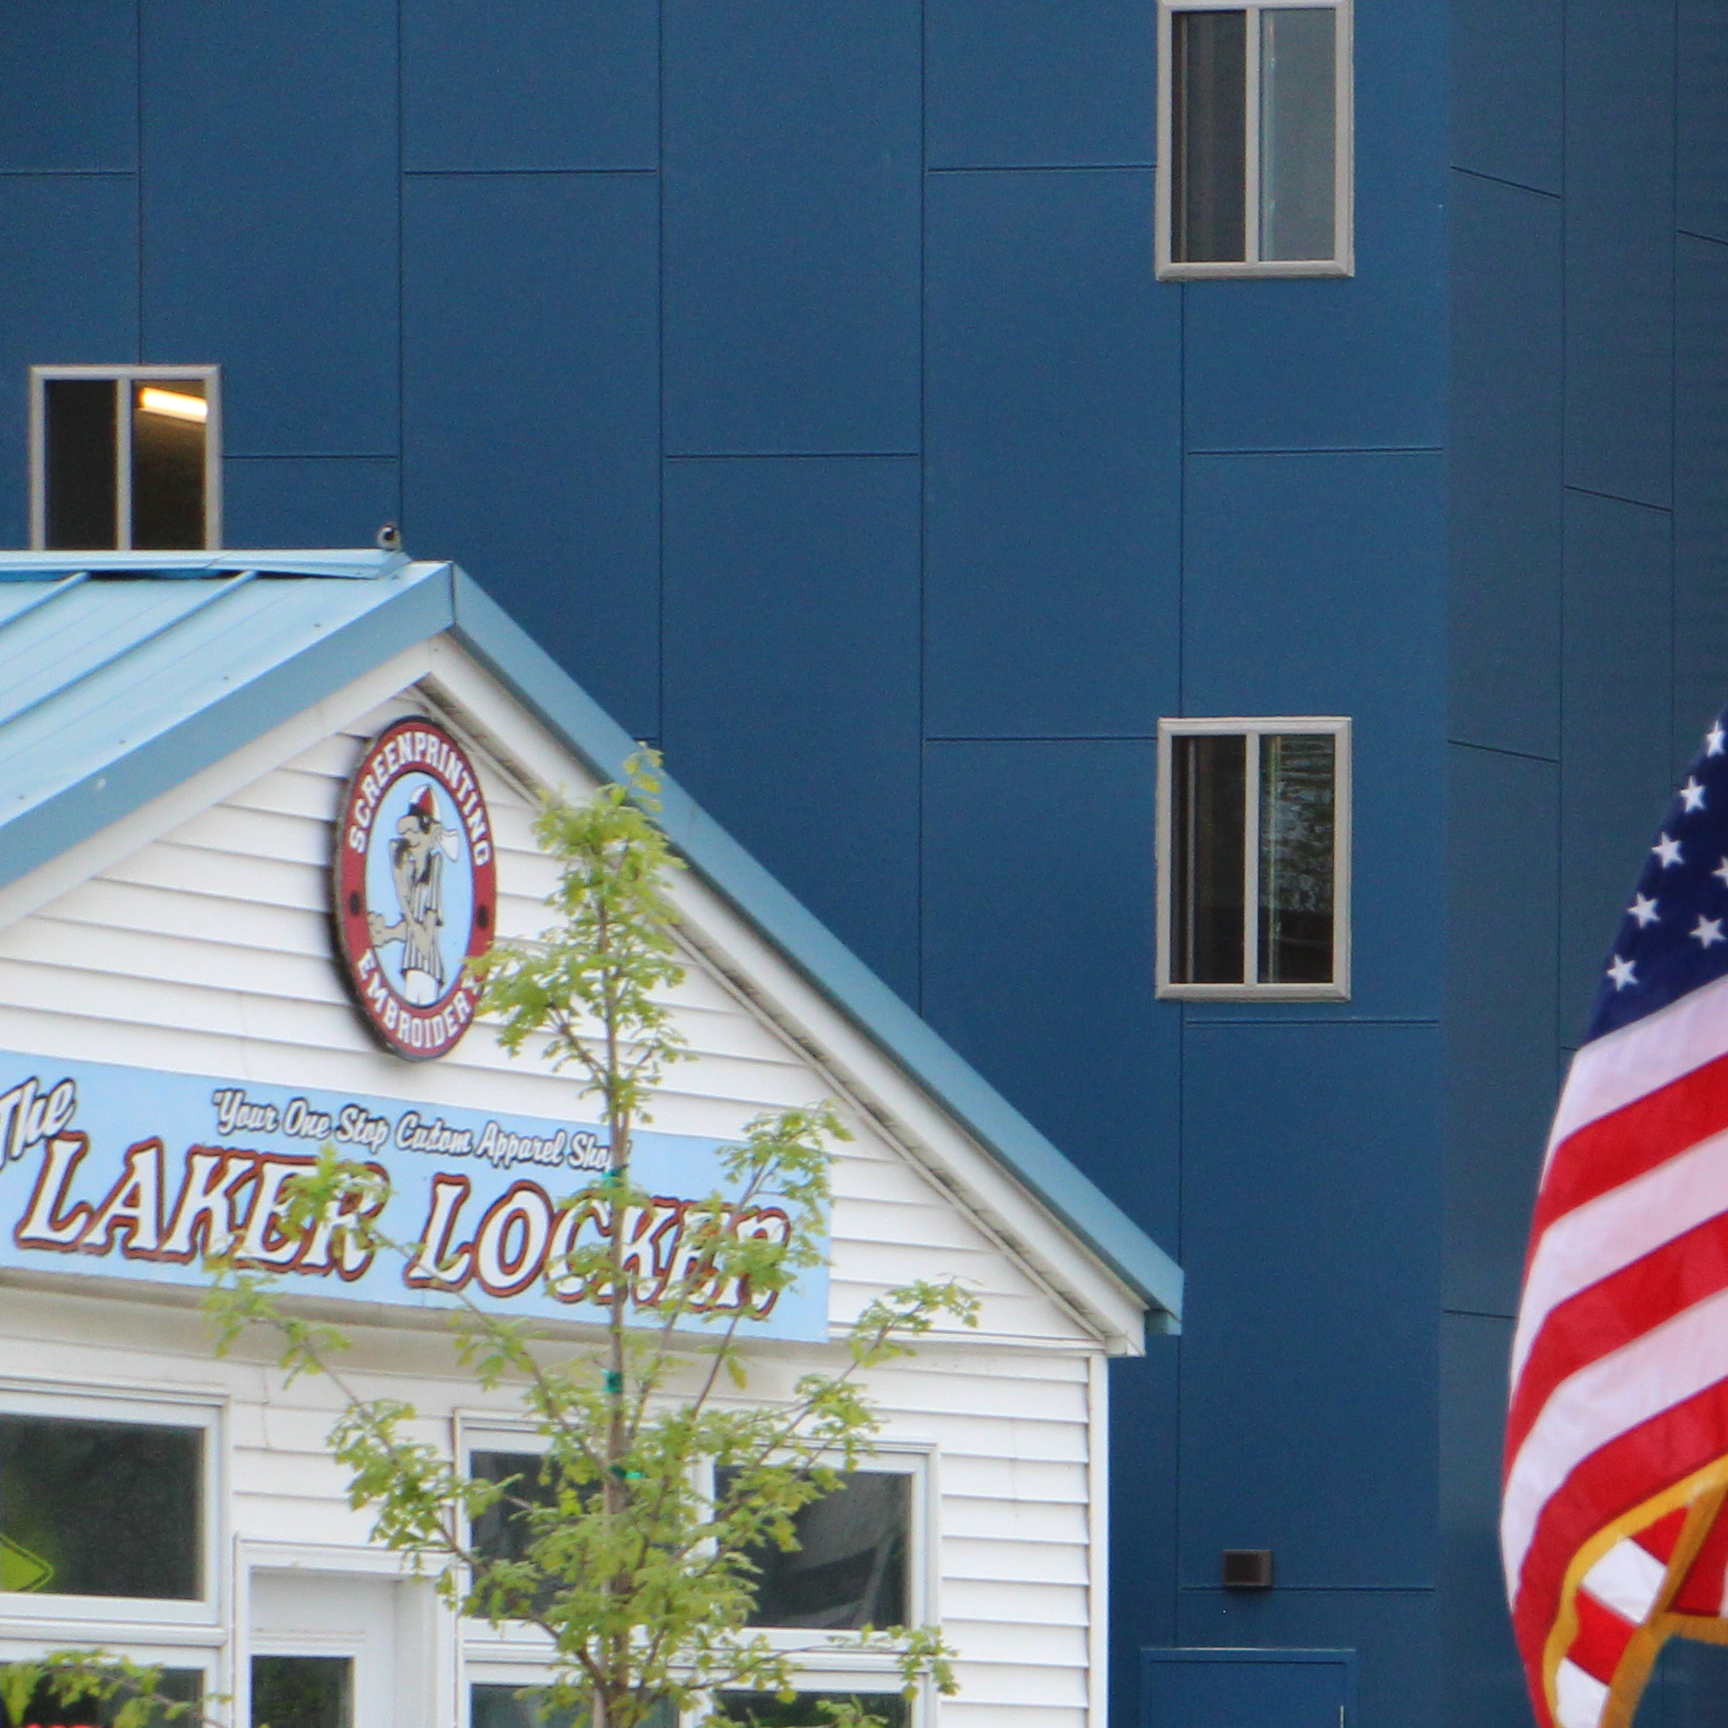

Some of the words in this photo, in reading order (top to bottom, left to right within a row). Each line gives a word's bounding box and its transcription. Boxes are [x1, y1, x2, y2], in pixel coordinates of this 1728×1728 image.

[349, 731, 490, 866] SCREENPRINTING
[0, 1076, 75, 1172] The
[282, 1097, 332, 1141] One
[334, 1103, 390, 1153] Stop
[477, 1120, 566, 1168] Apparel
[14, 1131, 391, 1281] LAKER
[404, 1173, 791, 1320] LOCKER
